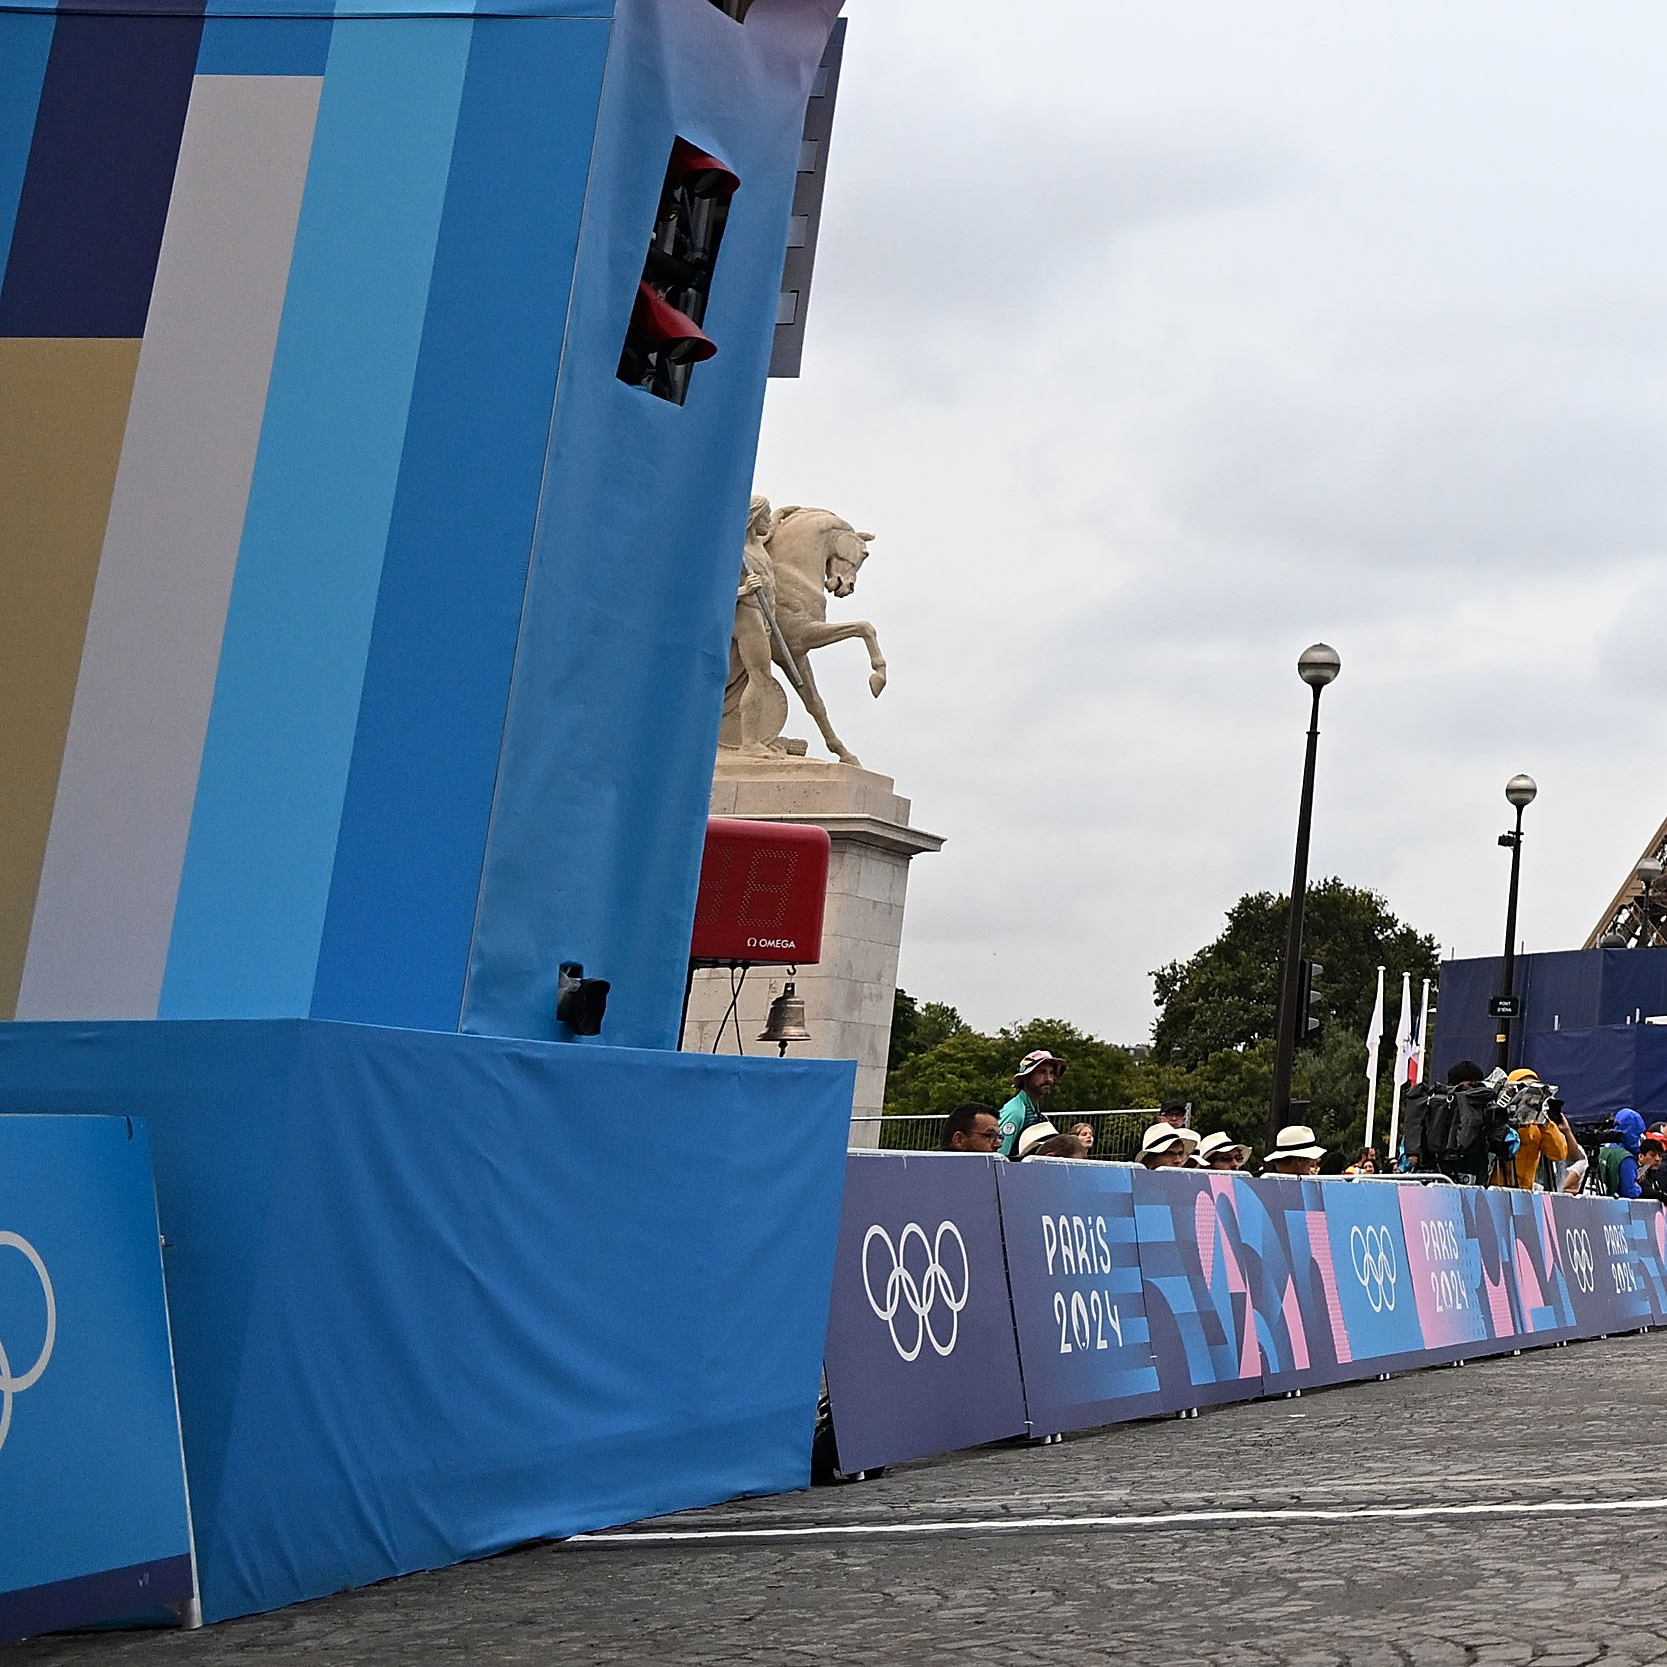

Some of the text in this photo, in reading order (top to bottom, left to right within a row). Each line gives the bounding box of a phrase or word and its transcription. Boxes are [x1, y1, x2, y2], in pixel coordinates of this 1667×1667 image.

[758, 938, 796, 949] OMEGA
[1430, 1270, 1470, 1312] 2024
[1611, 1261, 1638, 1294] 2024
[1053, 1290, 1123, 1353] 2024
